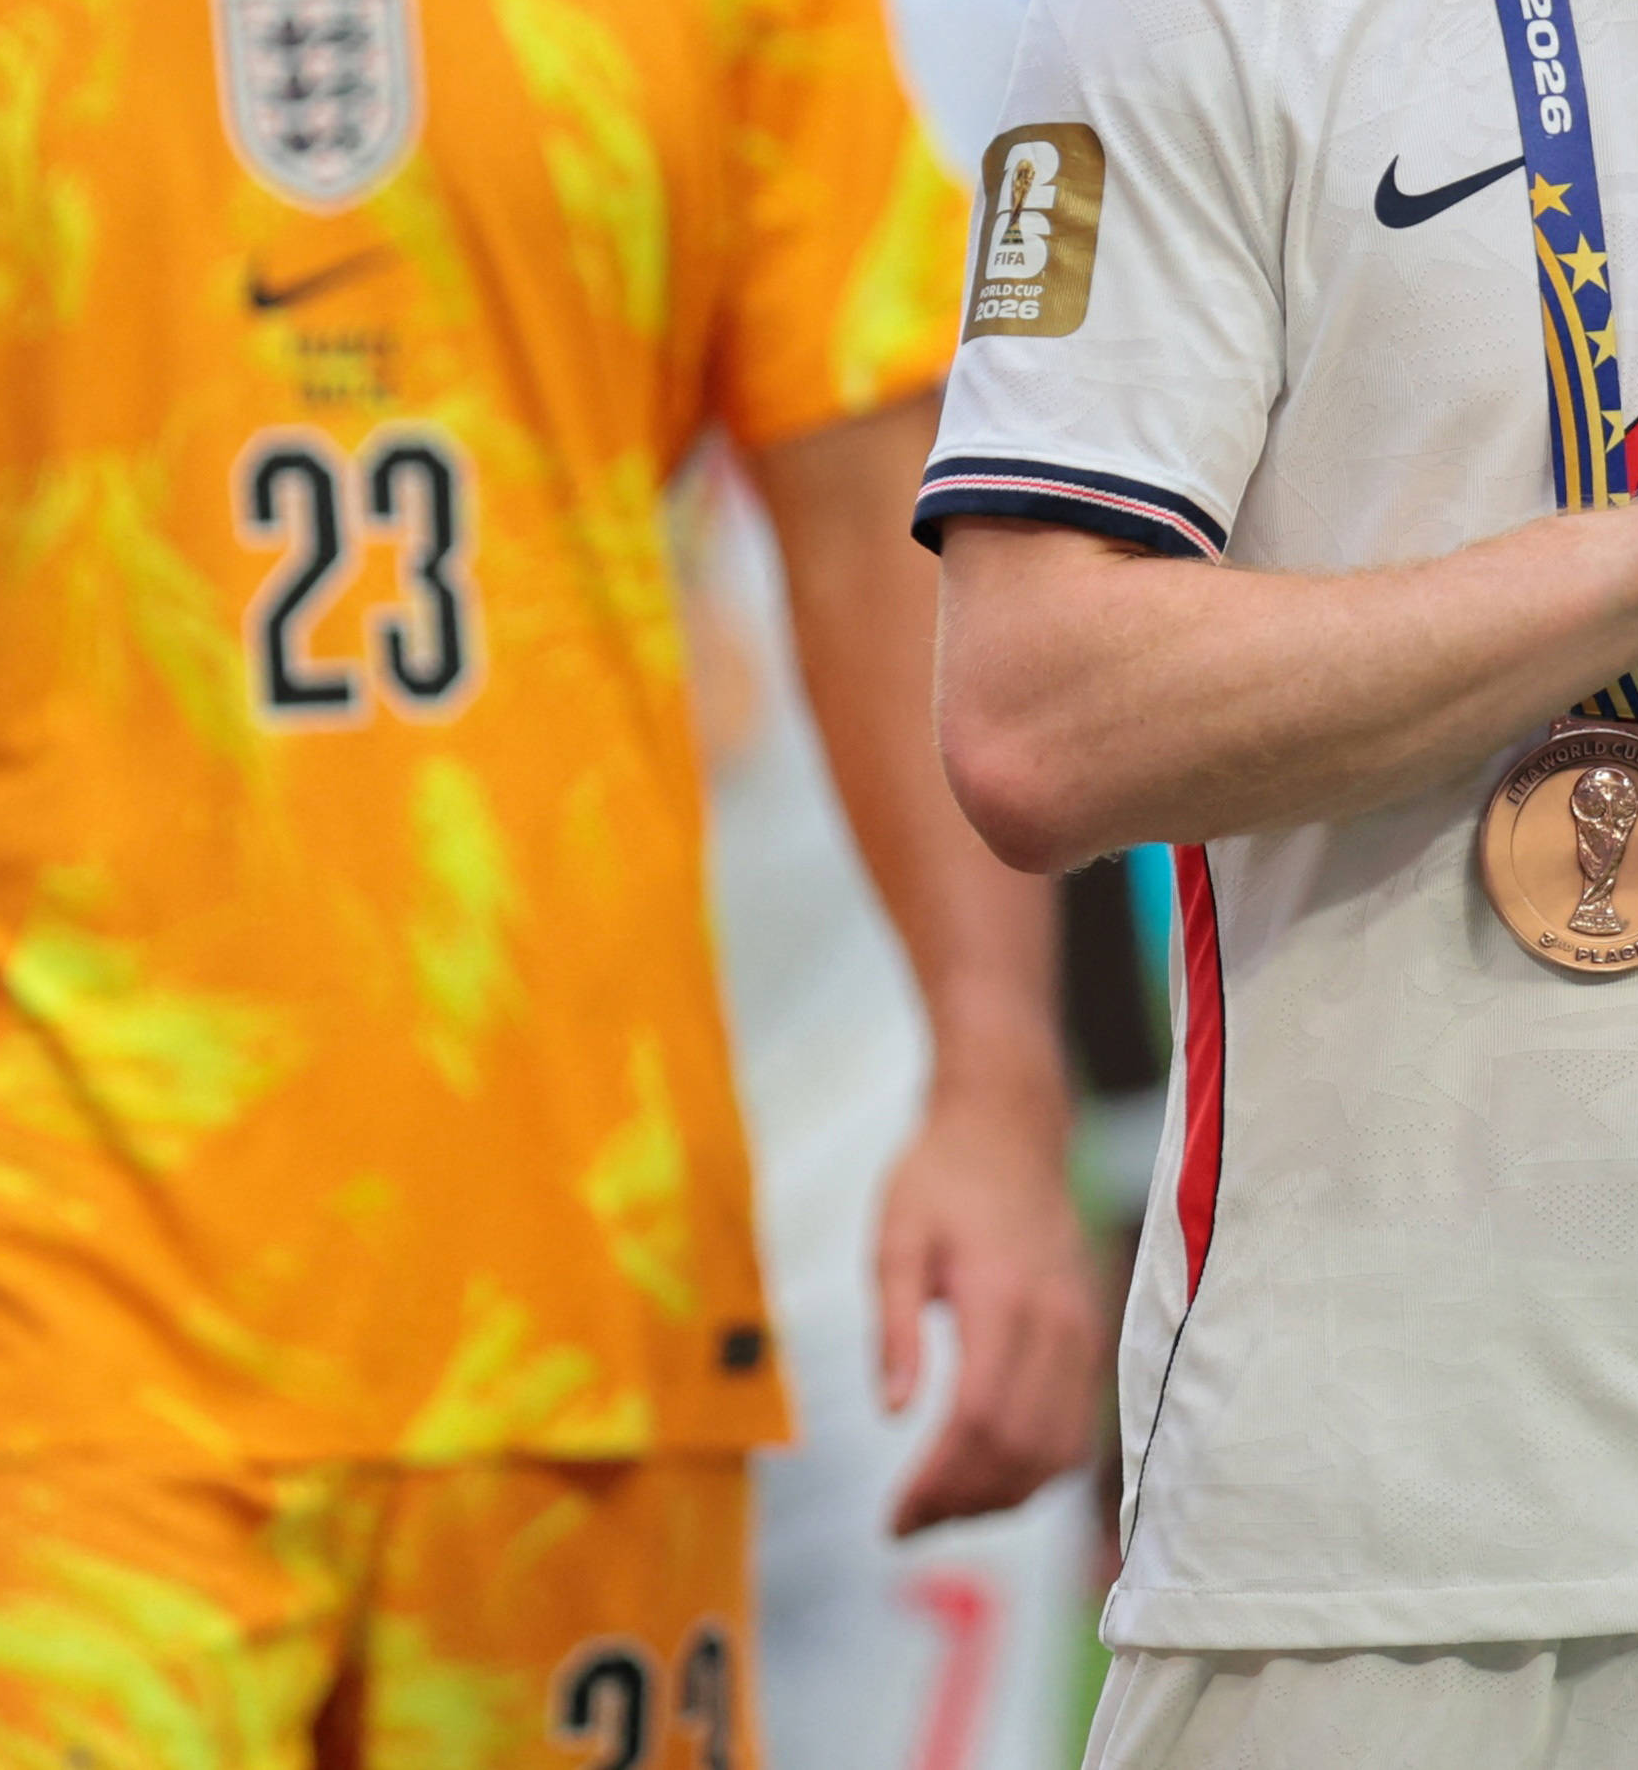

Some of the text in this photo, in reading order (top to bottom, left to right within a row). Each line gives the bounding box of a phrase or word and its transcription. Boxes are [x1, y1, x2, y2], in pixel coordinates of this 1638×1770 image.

[994, 252, 1026, 266] FIFA
[1014, 284, 1044, 298] CUP
[974, 299, 1040, 322] 2026
[239, 432, 479, 724] 23
[1507, 768, 1540, 806] FIFA
[1542, 741, 1607, 772] WORLD
